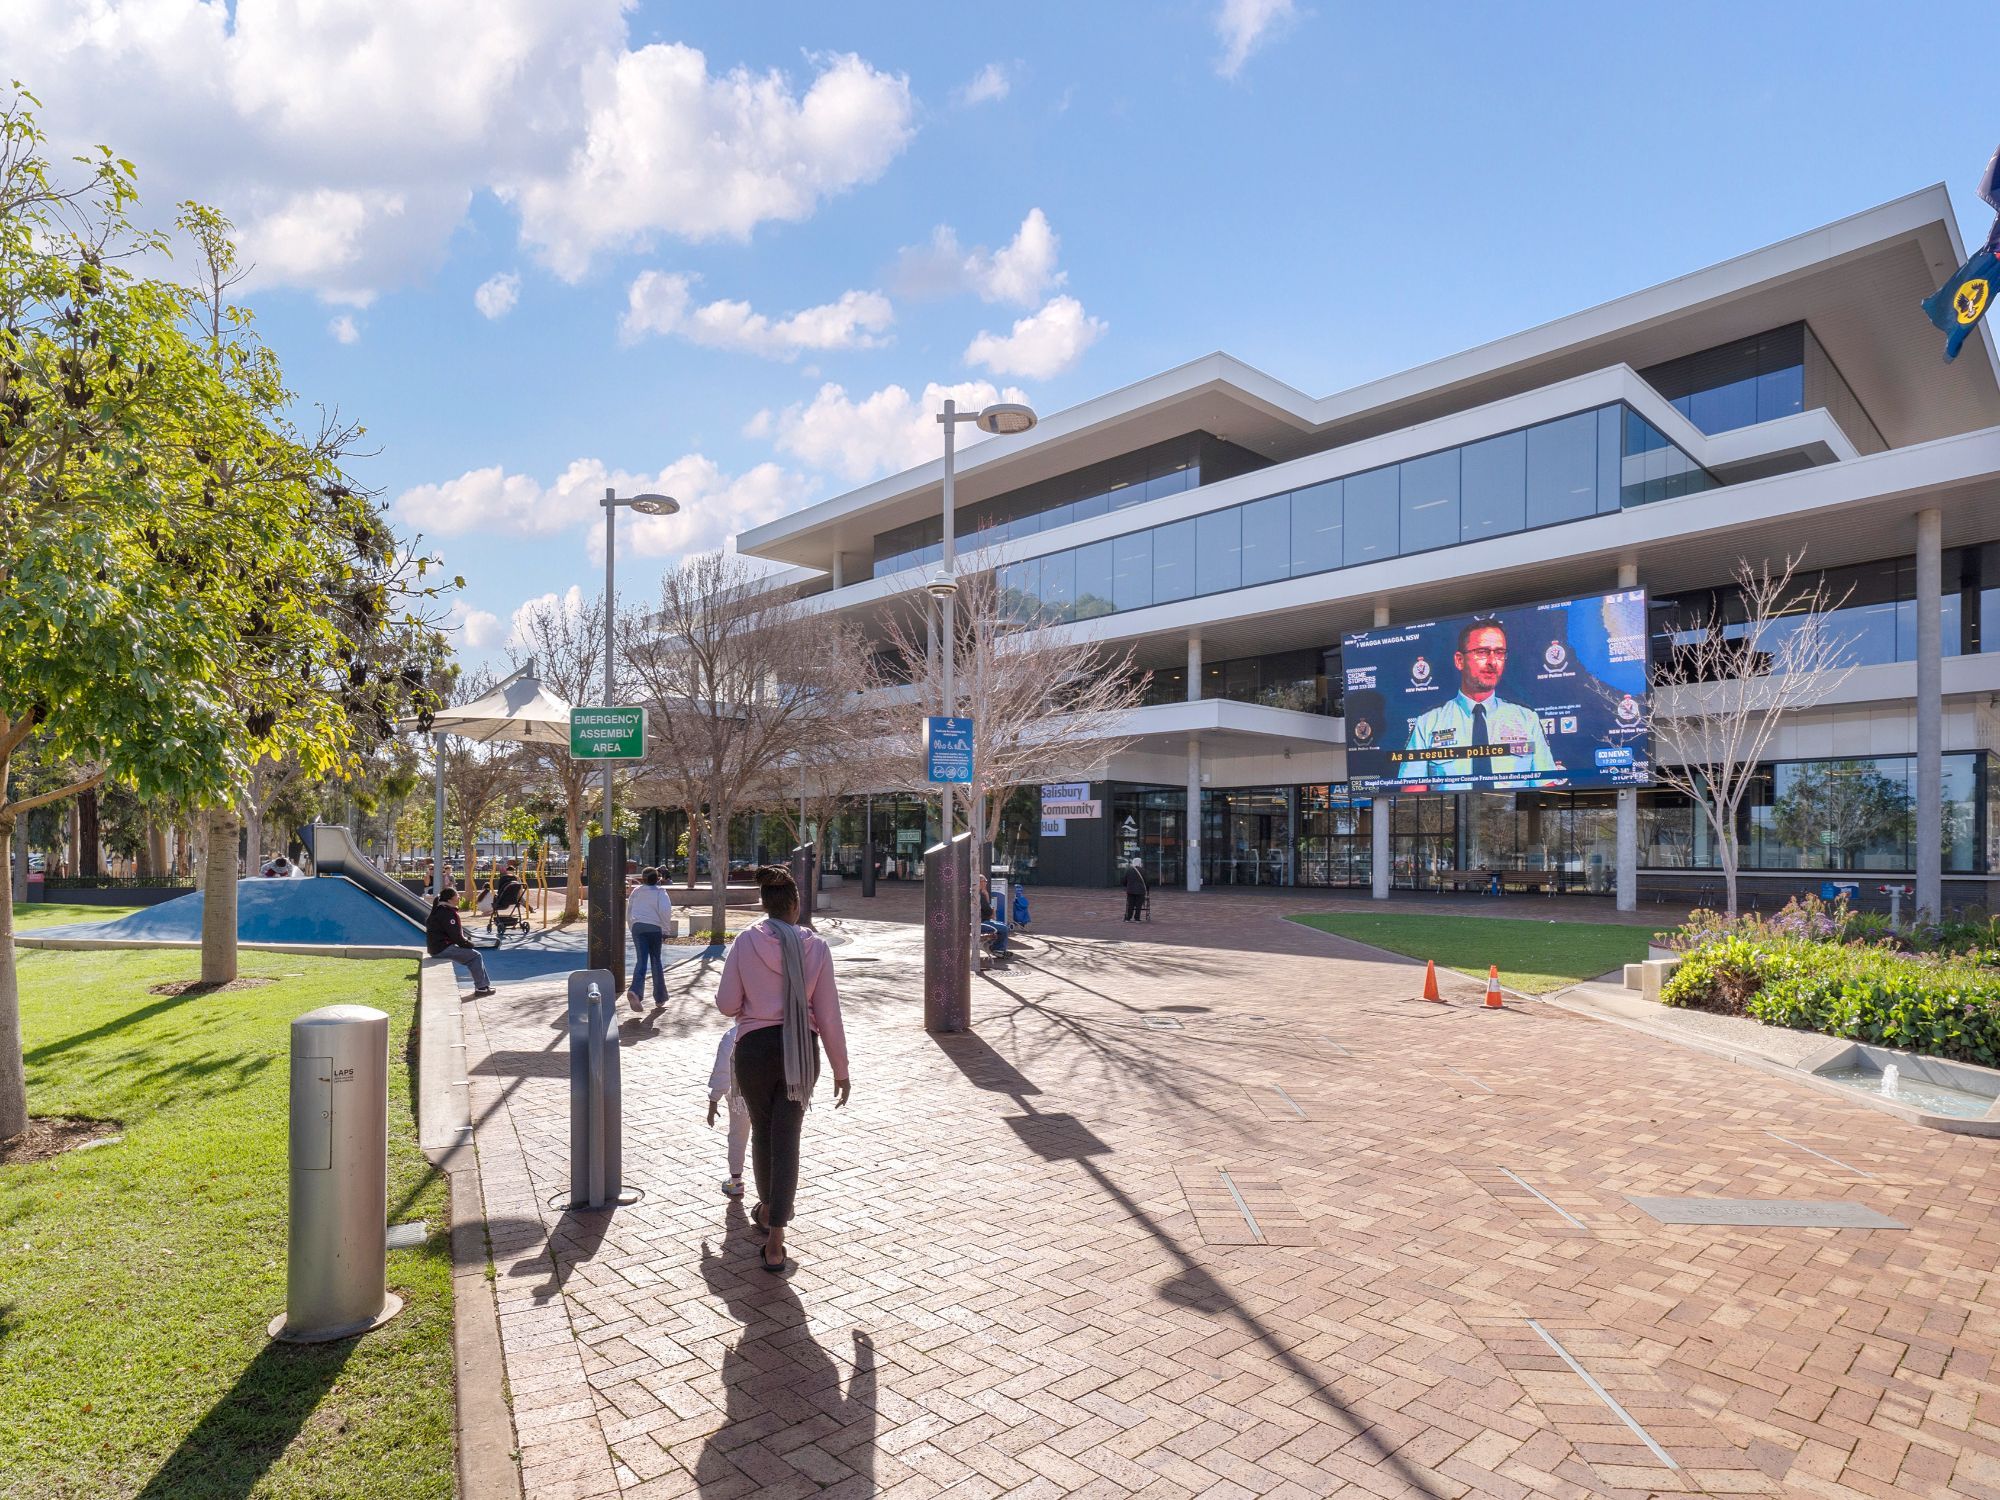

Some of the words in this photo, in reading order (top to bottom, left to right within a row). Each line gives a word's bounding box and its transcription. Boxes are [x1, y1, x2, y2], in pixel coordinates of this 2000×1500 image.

[1360, 640, 1381, 648] WAGGA
[1348, 676, 1376, 684] STOPPERS
[574, 715, 640, 724] EMERGENCY
[579, 729, 634, 738] ASSEMBLY
[593, 743, 621, 752] AREA
[1392, 752, 1402, 761] As
[1409, 752, 1414, 760] a
[1467, 745, 1503, 758] police
[1510, 743, 1528, 754] and
[1609, 750, 1629, 758] NEWS
[1042, 786, 1082, 799] Salisbury
[1042, 802, 1094, 816] Community
[1041, 820, 1059, 832] Hub
